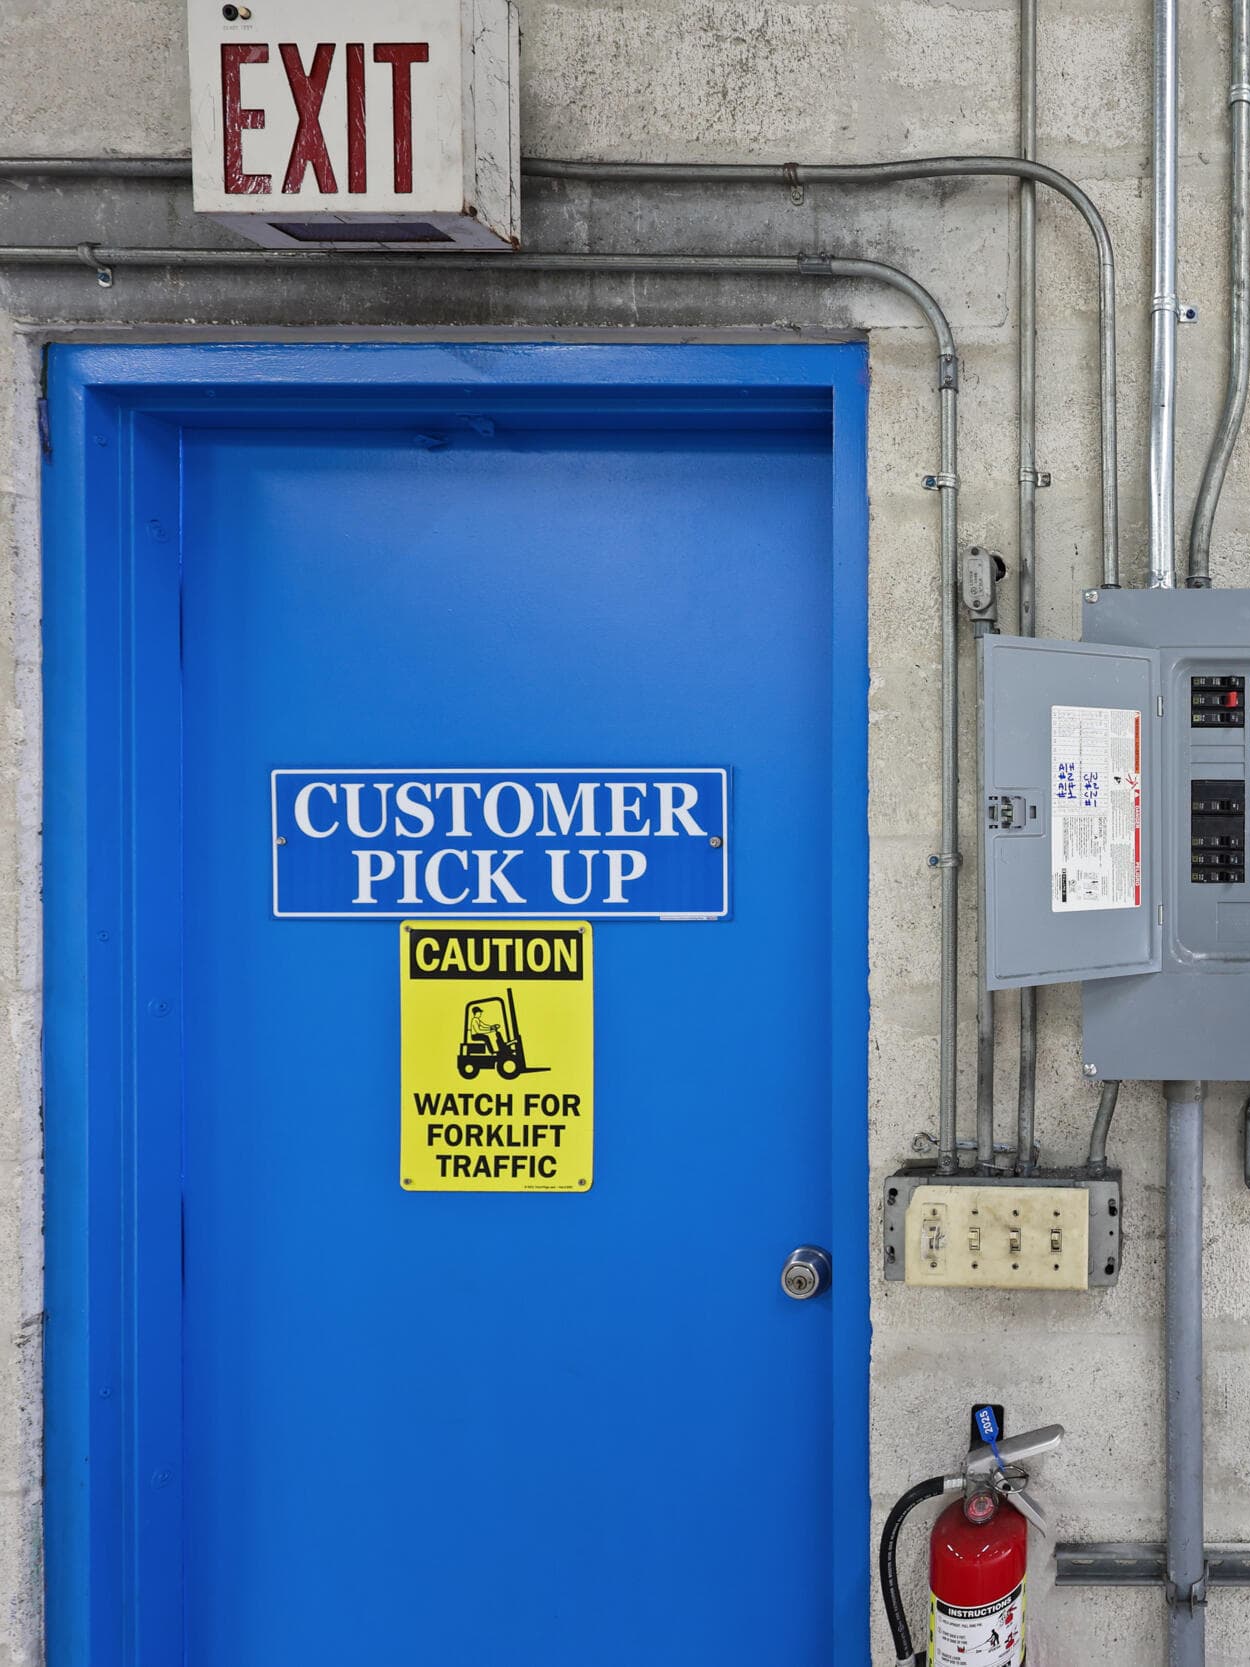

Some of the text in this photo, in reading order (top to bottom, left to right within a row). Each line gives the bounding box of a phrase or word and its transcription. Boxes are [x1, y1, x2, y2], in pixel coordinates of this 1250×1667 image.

[221, 42, 429, 195] EXIT
[294, 782, 708, 839] CUSTOMER
[351, 848, 647, 905] PICK UP
[415, 937, 577, 973] CAUTION
[413, 1093, 581, 1117] WATCH FOR
[427, 1124, 566, 1148] FORKLIFT
[435, 1154, 557, 1178] TRAFFIC
[980, 1410, 994, 1434] 2025
[948, 1597, 1012, 1618] INSTRUCTIONS
